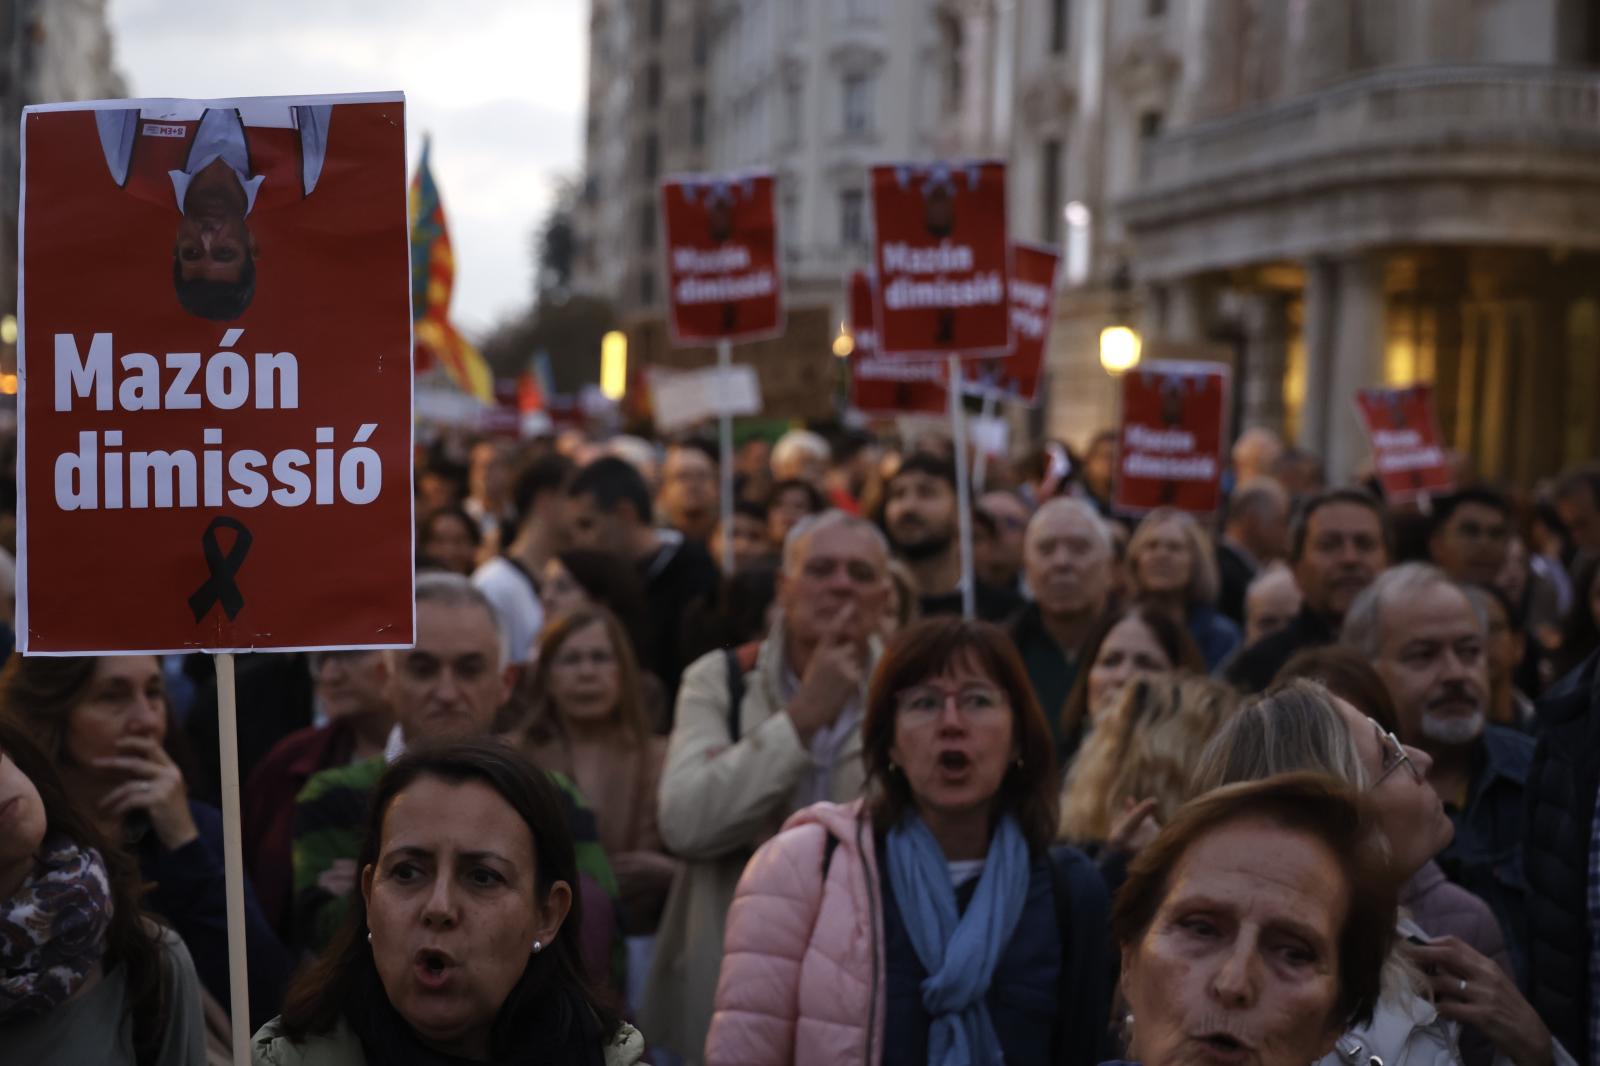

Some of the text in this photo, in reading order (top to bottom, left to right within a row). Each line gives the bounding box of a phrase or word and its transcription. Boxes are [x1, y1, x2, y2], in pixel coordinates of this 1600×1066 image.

[883, 240, 972, 273] Mazón
[885, 272, 1003, 310] dimissió
[54, 328, 299, 411] Mazón
[54, 423, 382, 510] dimissió
